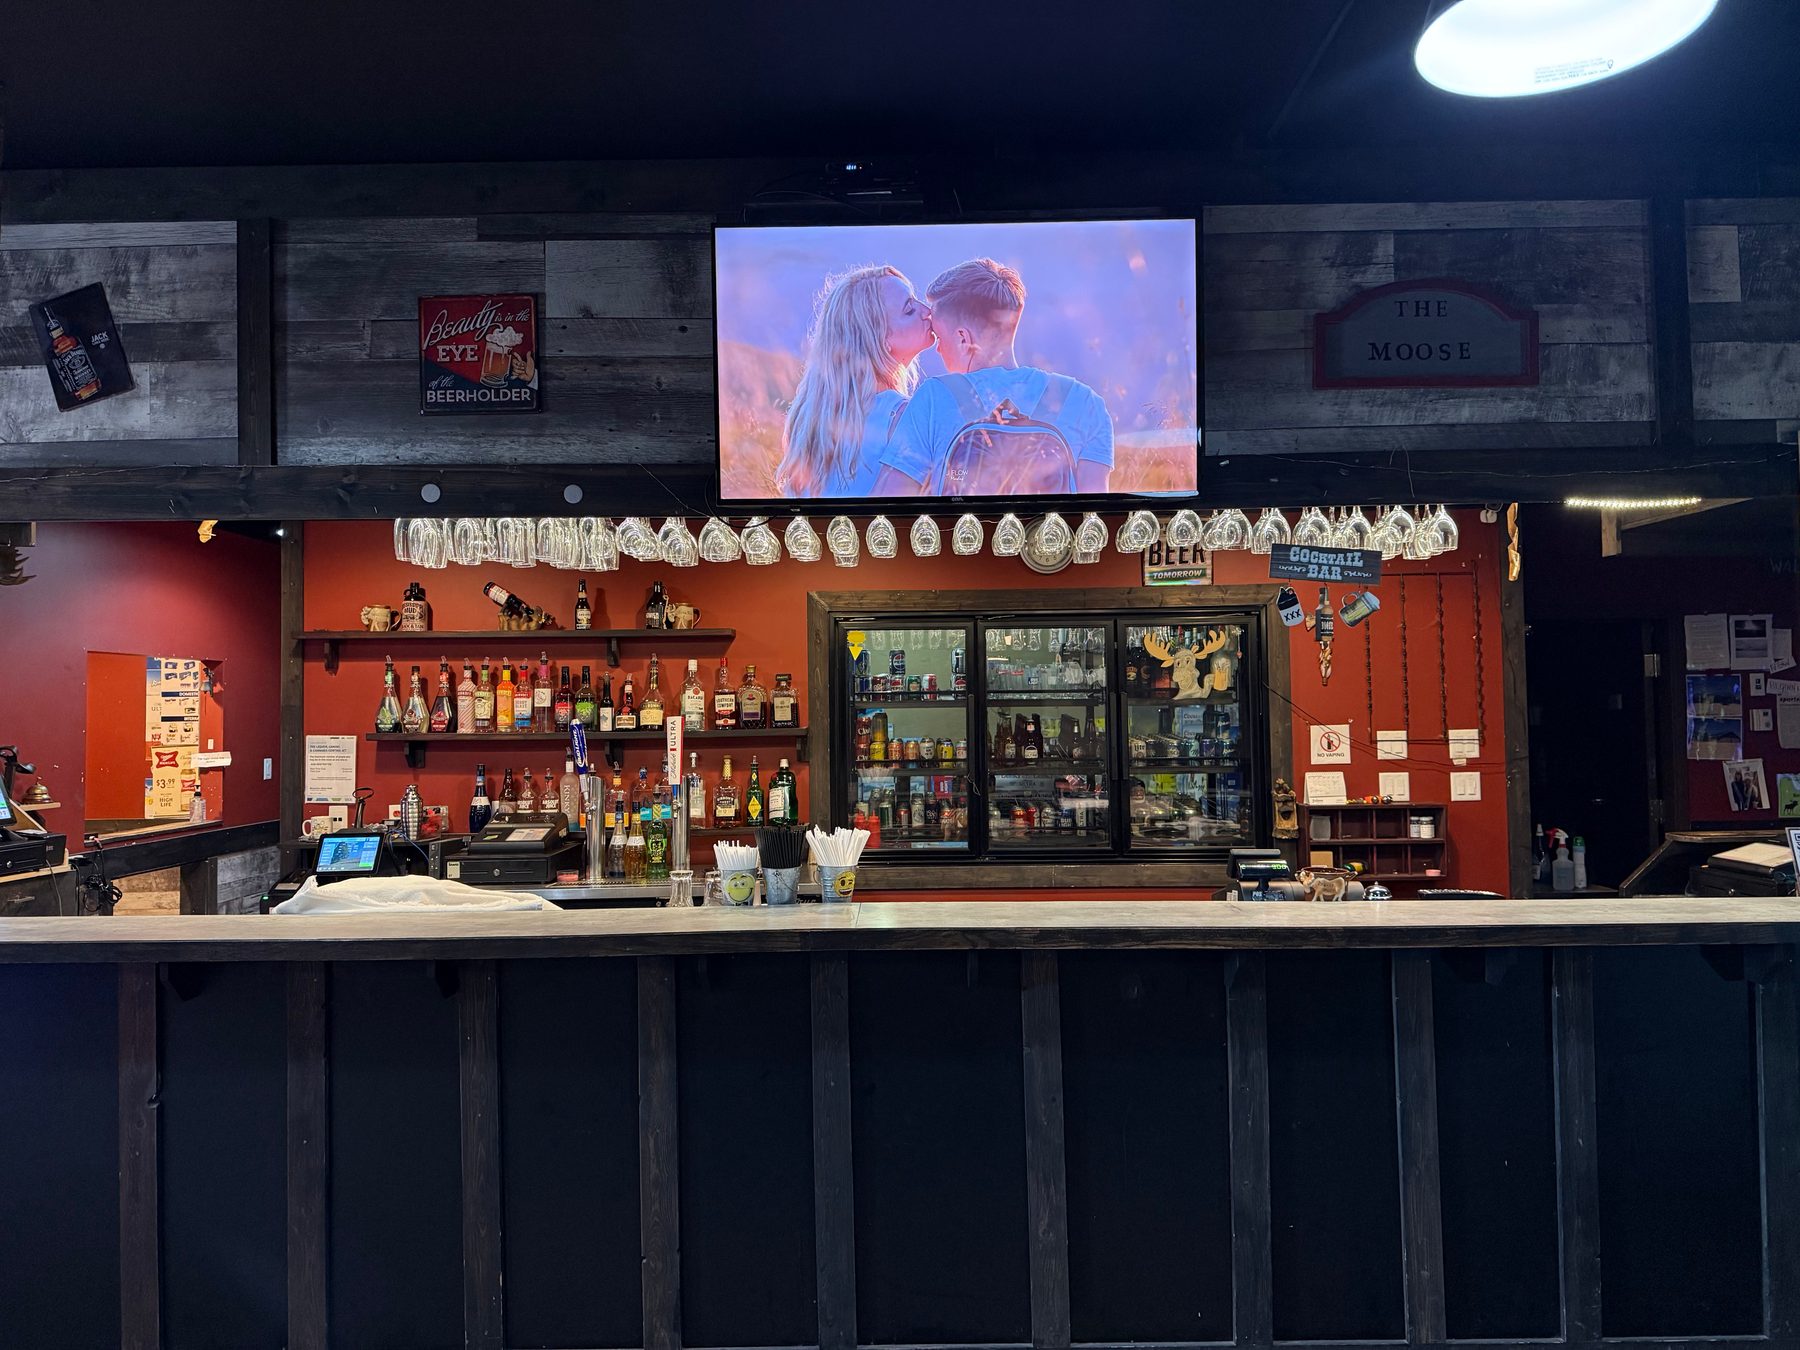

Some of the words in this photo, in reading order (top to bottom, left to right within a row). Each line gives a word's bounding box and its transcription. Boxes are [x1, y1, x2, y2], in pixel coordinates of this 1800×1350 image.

[1394, 300, 1448, 317] THE
[423, 300, 504, 351] Beauty
[495, 313, 502, 321] is
[505, 313, 513, 321] in
[516, 309, 530, 321] the
[91, 331, 109, 343] JACK
[437, 344, 478, 362] EYE
[1368, 342, 1471, 361] MOOSE
[428, 376, 440, 390] of
[440, 375, 455, 387] the
[426, 389, 531, 402] BEERHOLDER
[1149, 540, 1205, 566] BEER
[1290, 547, 1363, 567] COCKTAIL
[1153, 569, 1203, 580] TOMORROW
[1307, 564, 1342, 580] BAR
[1283, 608, 1302, 622] XXX
[156, 779, 175, 789] $3.99
